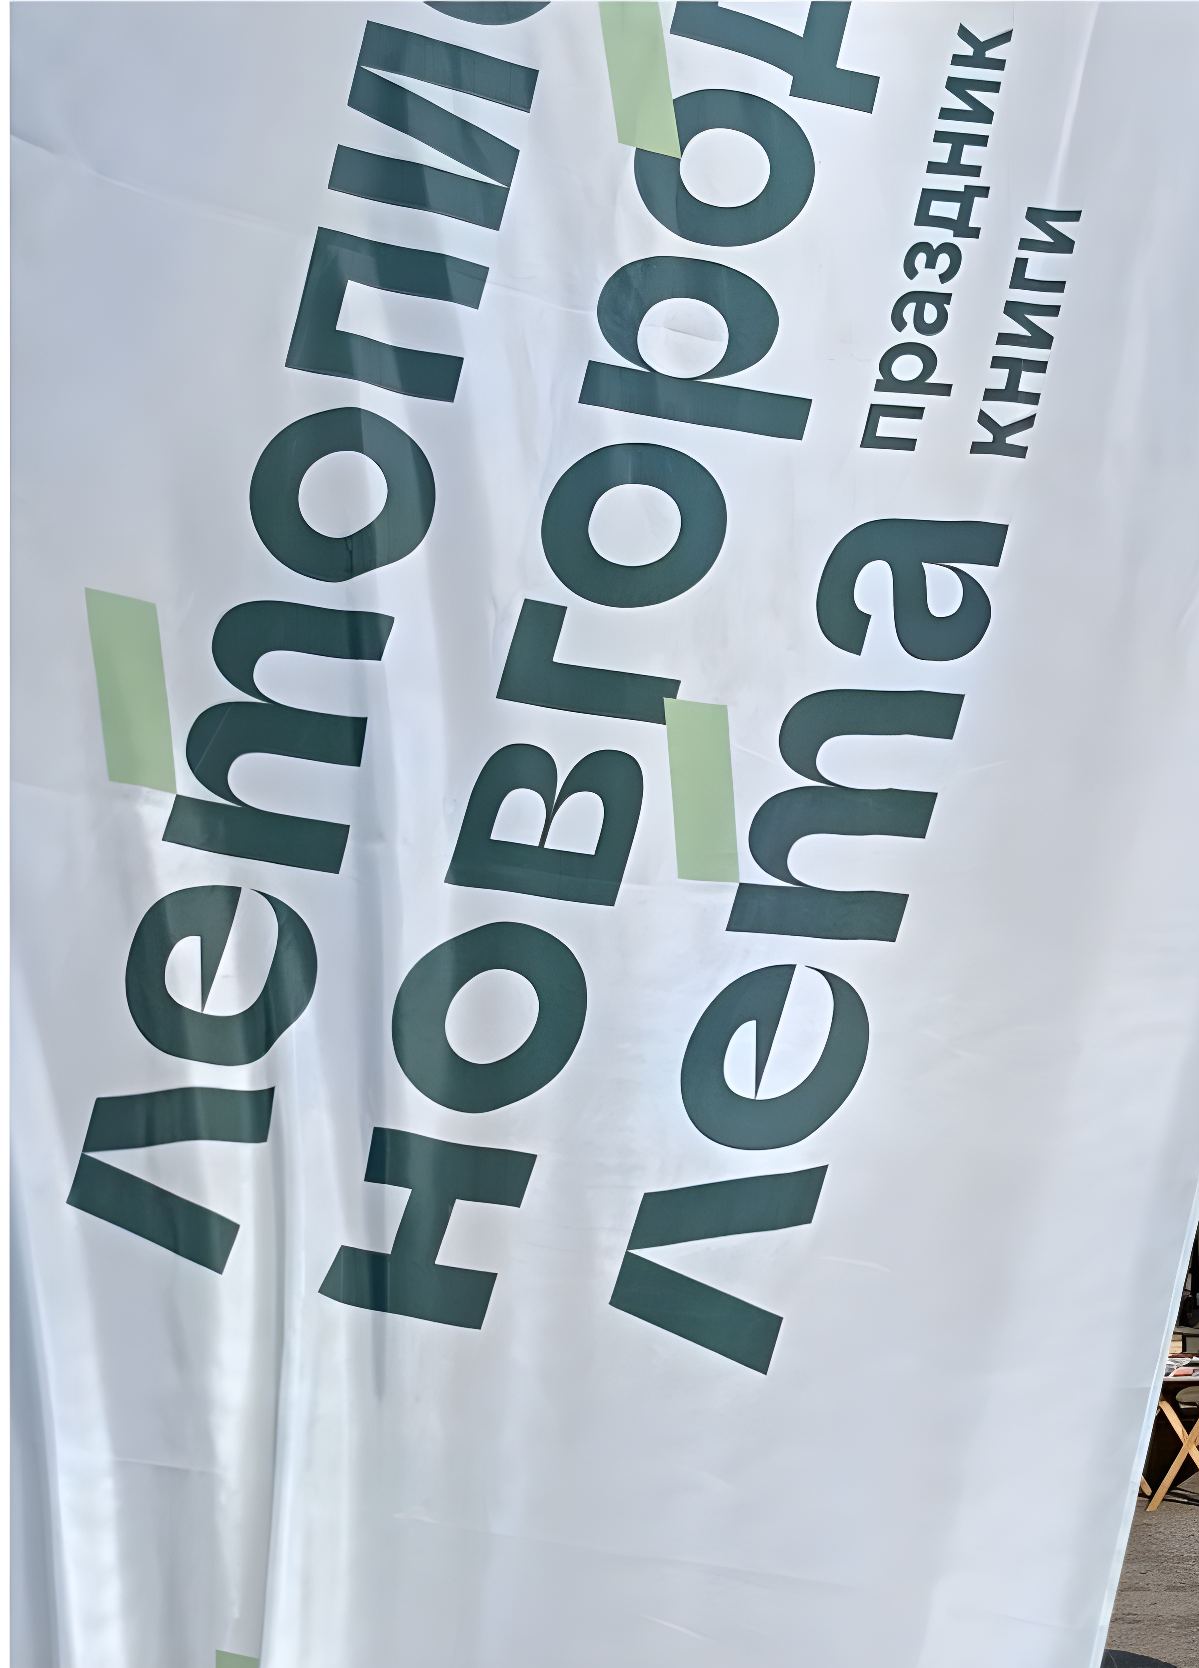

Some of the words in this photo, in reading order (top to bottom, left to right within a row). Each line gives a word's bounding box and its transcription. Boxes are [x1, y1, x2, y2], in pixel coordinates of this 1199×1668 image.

[860, 22, 1014, 451] праздник
[969, 207, 1083, 458] книги
[66, 1, 550, 1274] летопи
